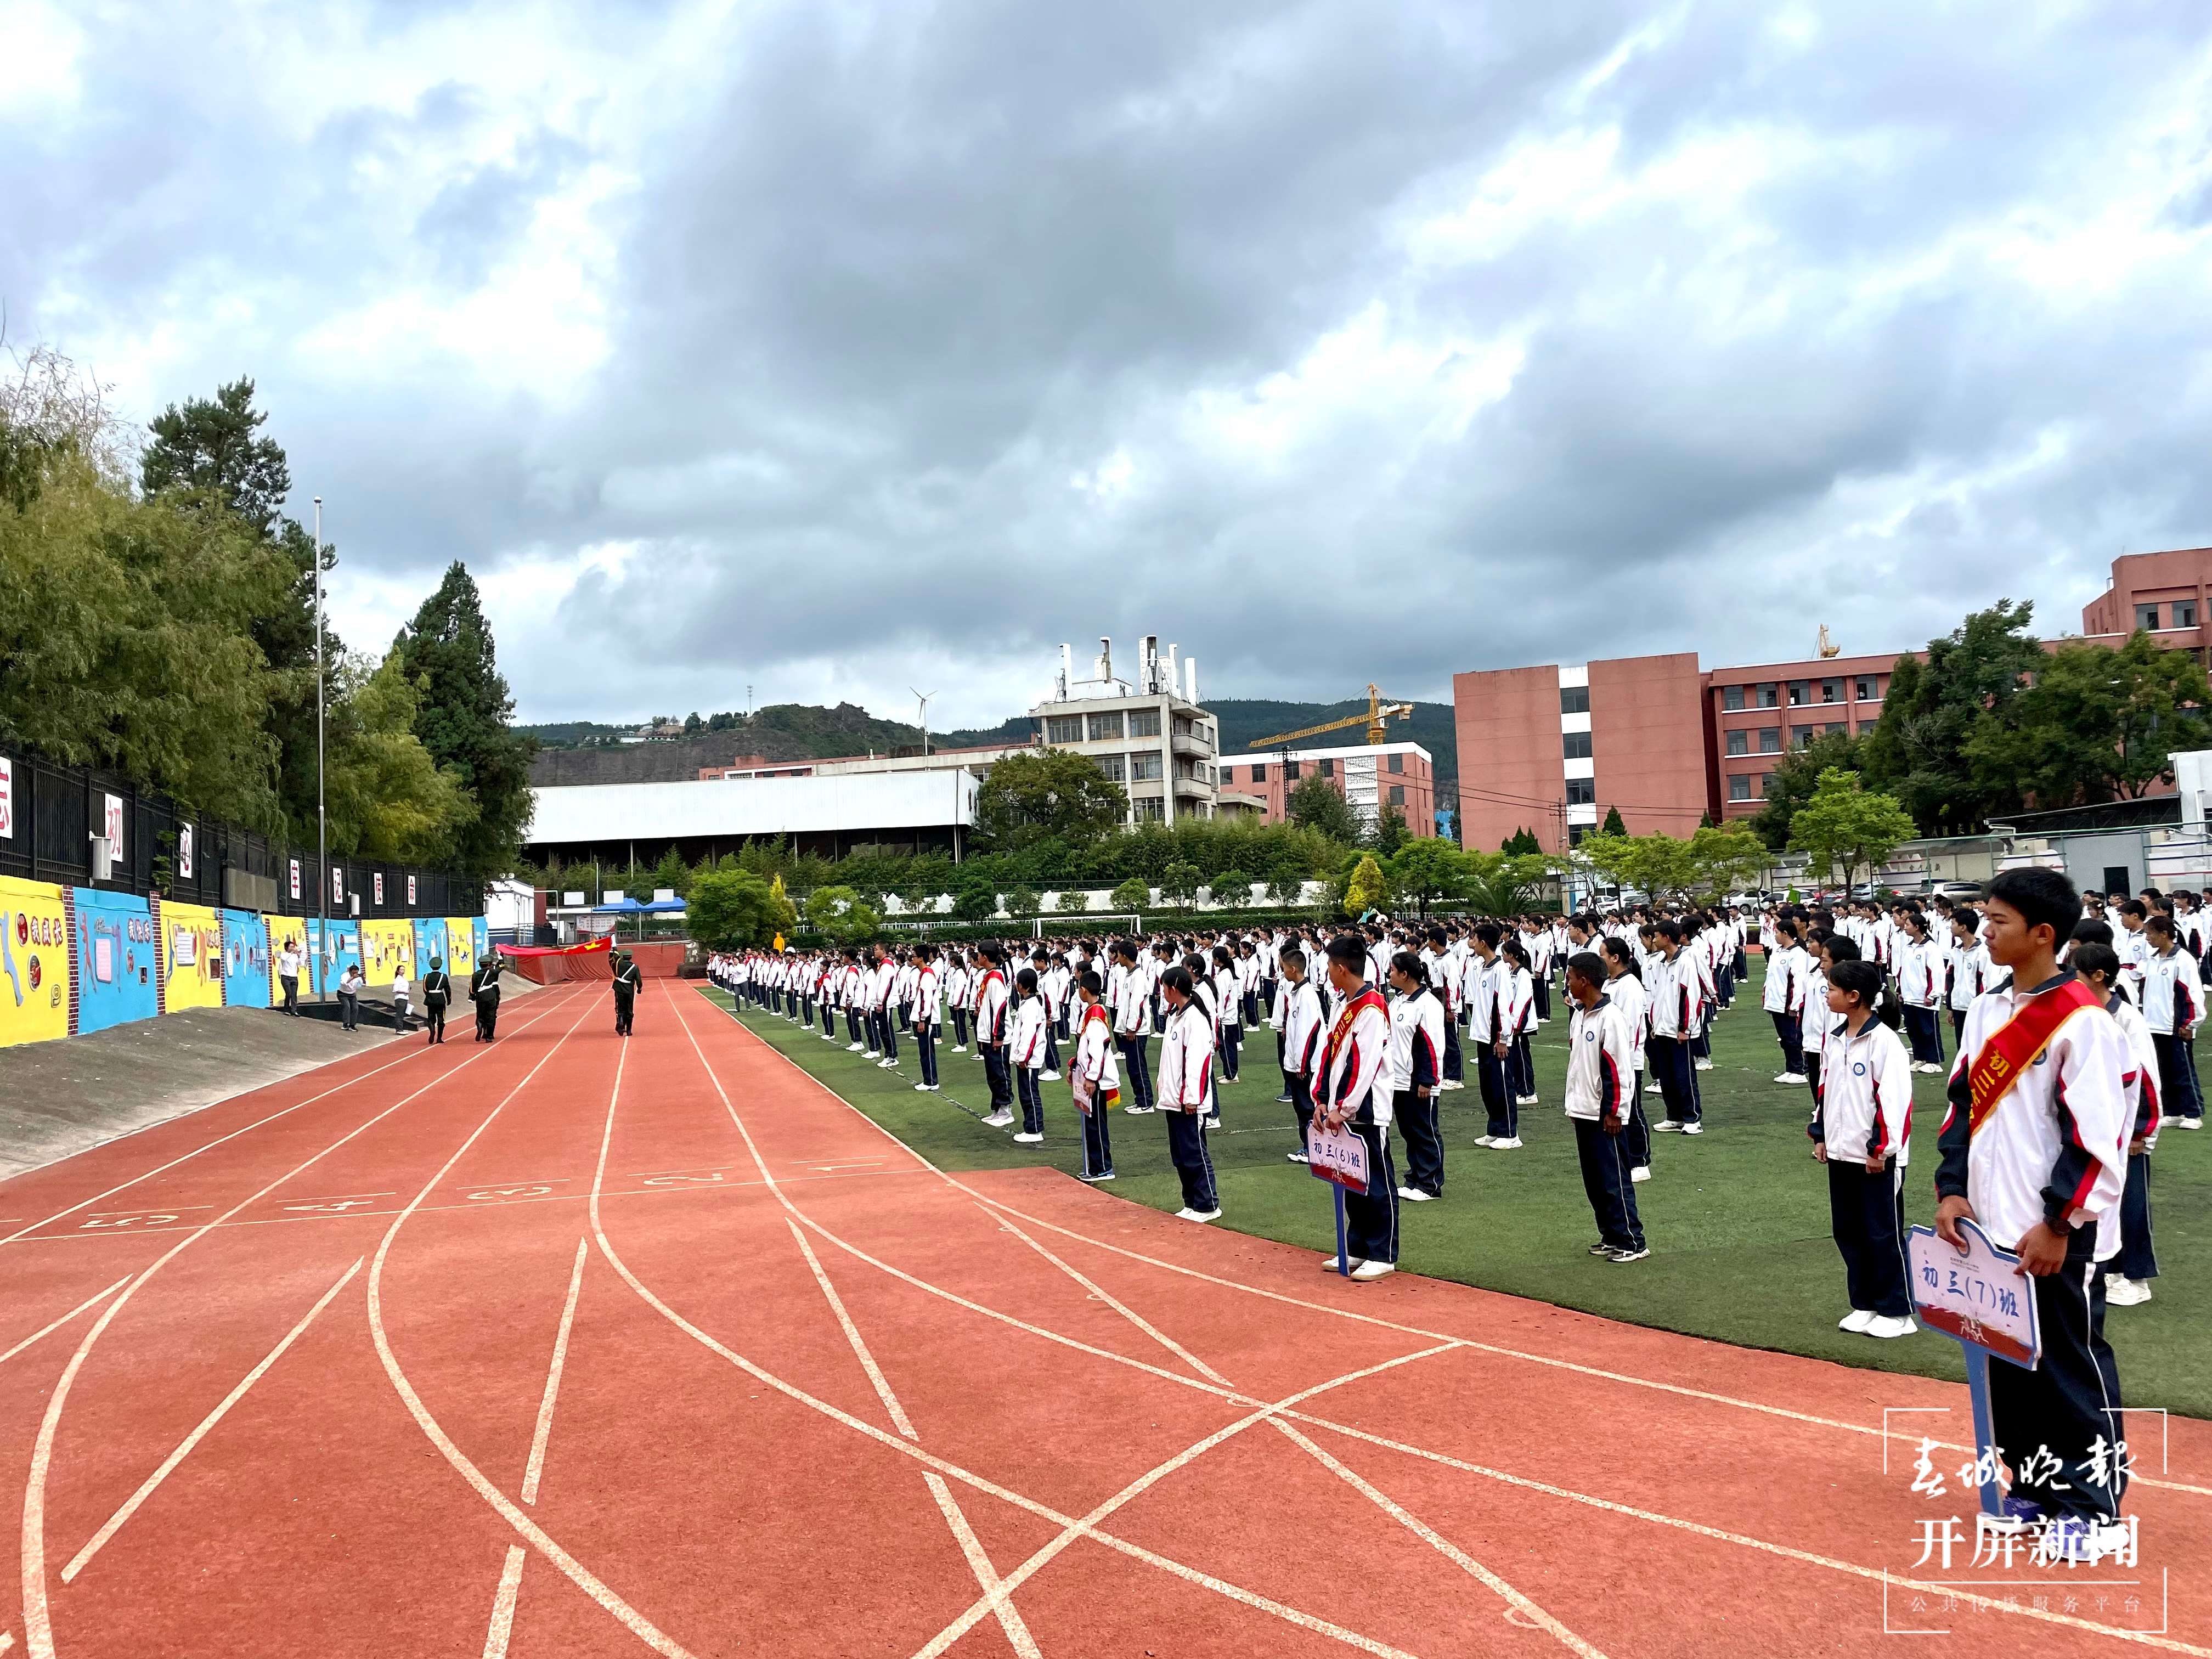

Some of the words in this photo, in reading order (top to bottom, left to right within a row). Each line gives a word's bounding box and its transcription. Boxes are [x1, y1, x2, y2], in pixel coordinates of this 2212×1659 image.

[1314, 1138, 1361, 1169] 初三(6)班
[1921, 1260, 2020, 1318] 初三(7)班
